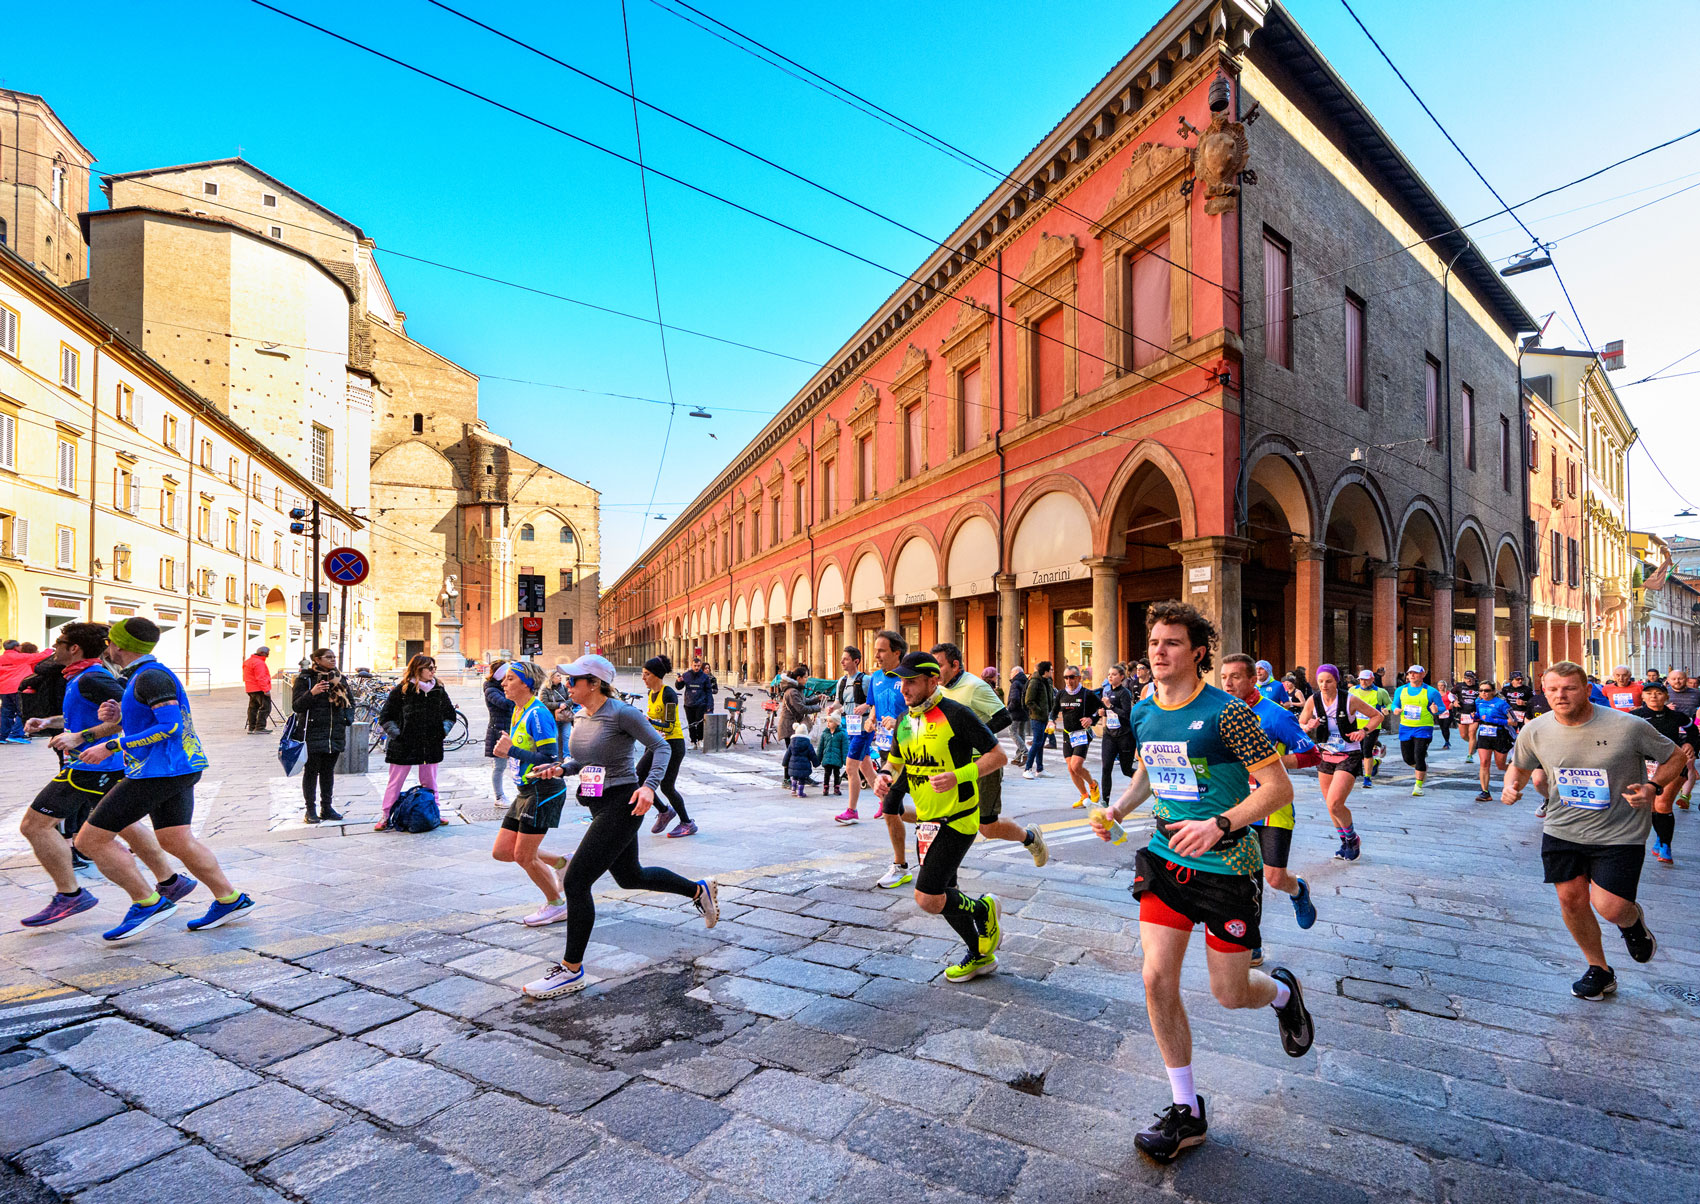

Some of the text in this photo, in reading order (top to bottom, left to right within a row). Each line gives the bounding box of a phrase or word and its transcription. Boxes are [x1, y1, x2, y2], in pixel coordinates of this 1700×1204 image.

[1033, 567, 1070, 584] Zanarini
[904, 593, 926, 603] Zanarini
[1157, 772, 1186, 785] 1473
[1571, 789, 1596, 799] 826
